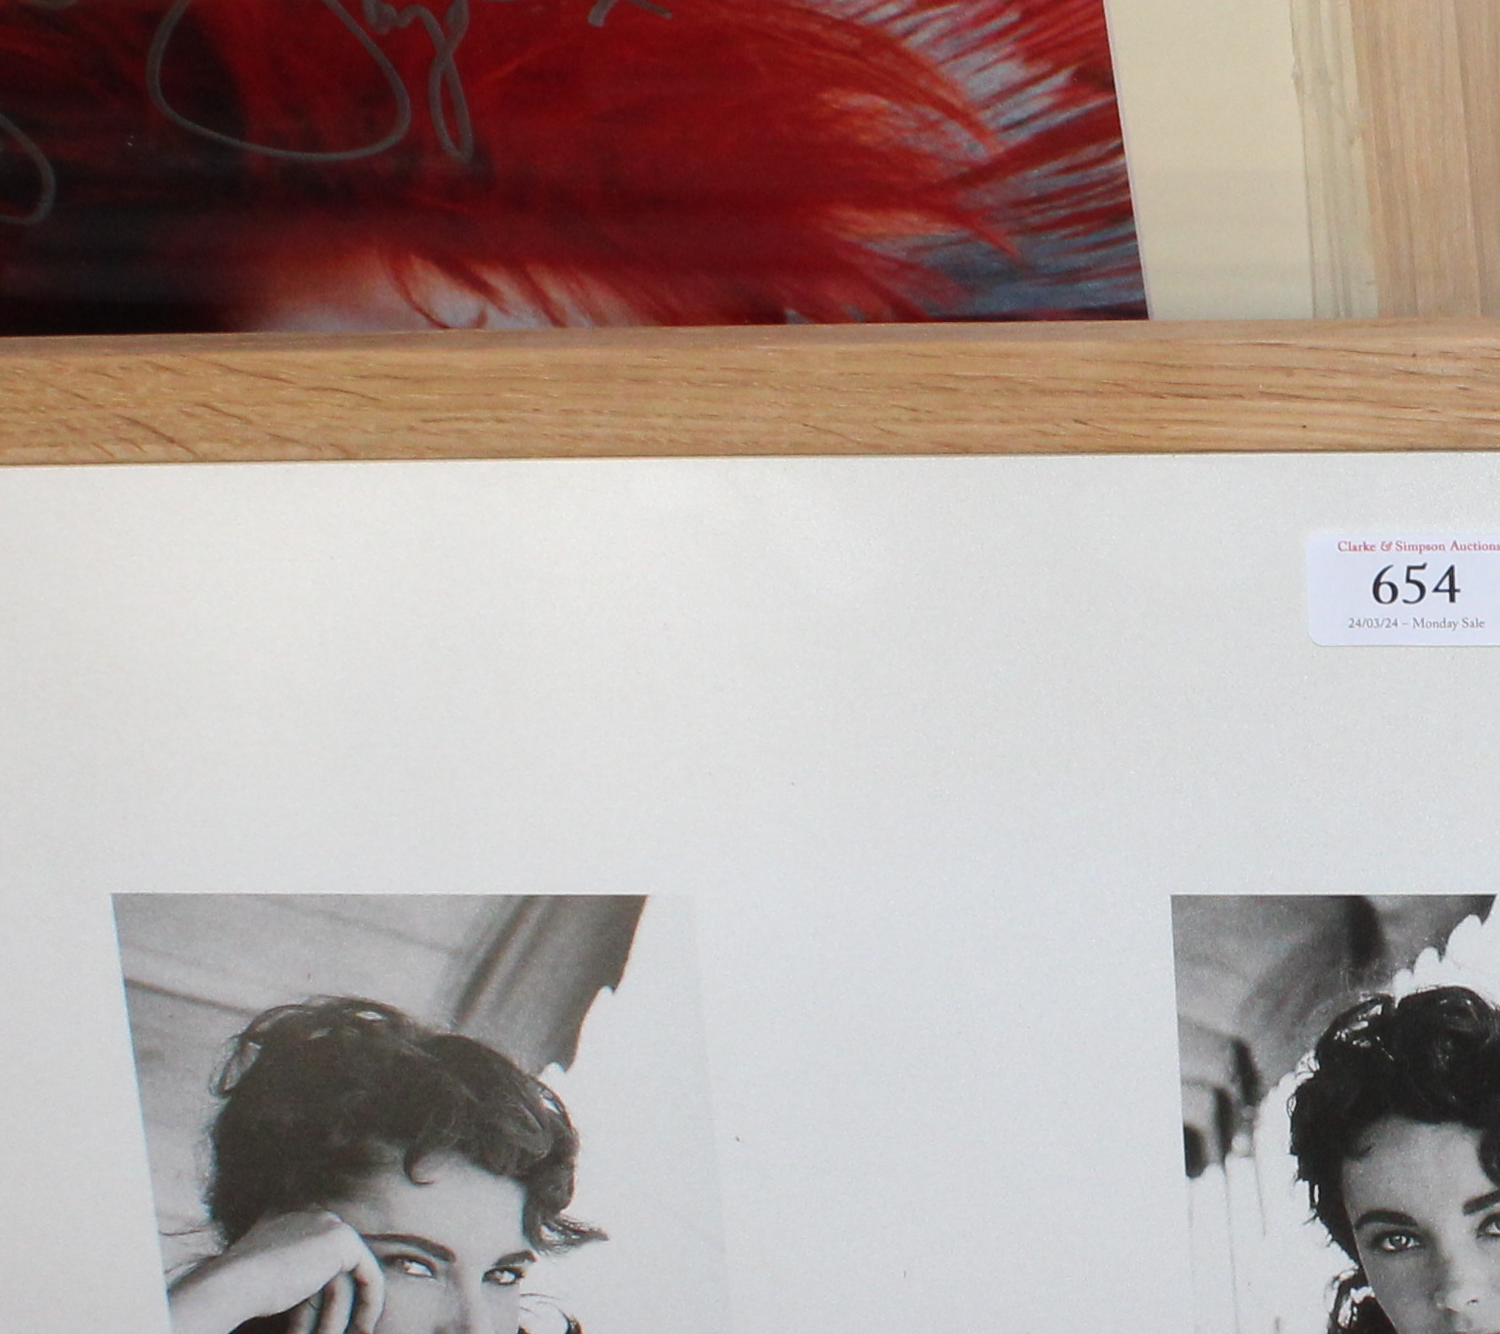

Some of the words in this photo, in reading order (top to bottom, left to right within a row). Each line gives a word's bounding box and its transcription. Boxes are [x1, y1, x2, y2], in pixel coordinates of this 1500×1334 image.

[1337, 540, 1376, 553] Clarke
[1380, 540, 1393, 553] &
[1395, 540, 1446, 555] Simpson
[1372, 562, 1461, 605] 654
[1348, 617, 1399, 630] 24/03/24
[1412, 617, 1459, 632] Monday
[1461, 617, 1486, 630] Sale
